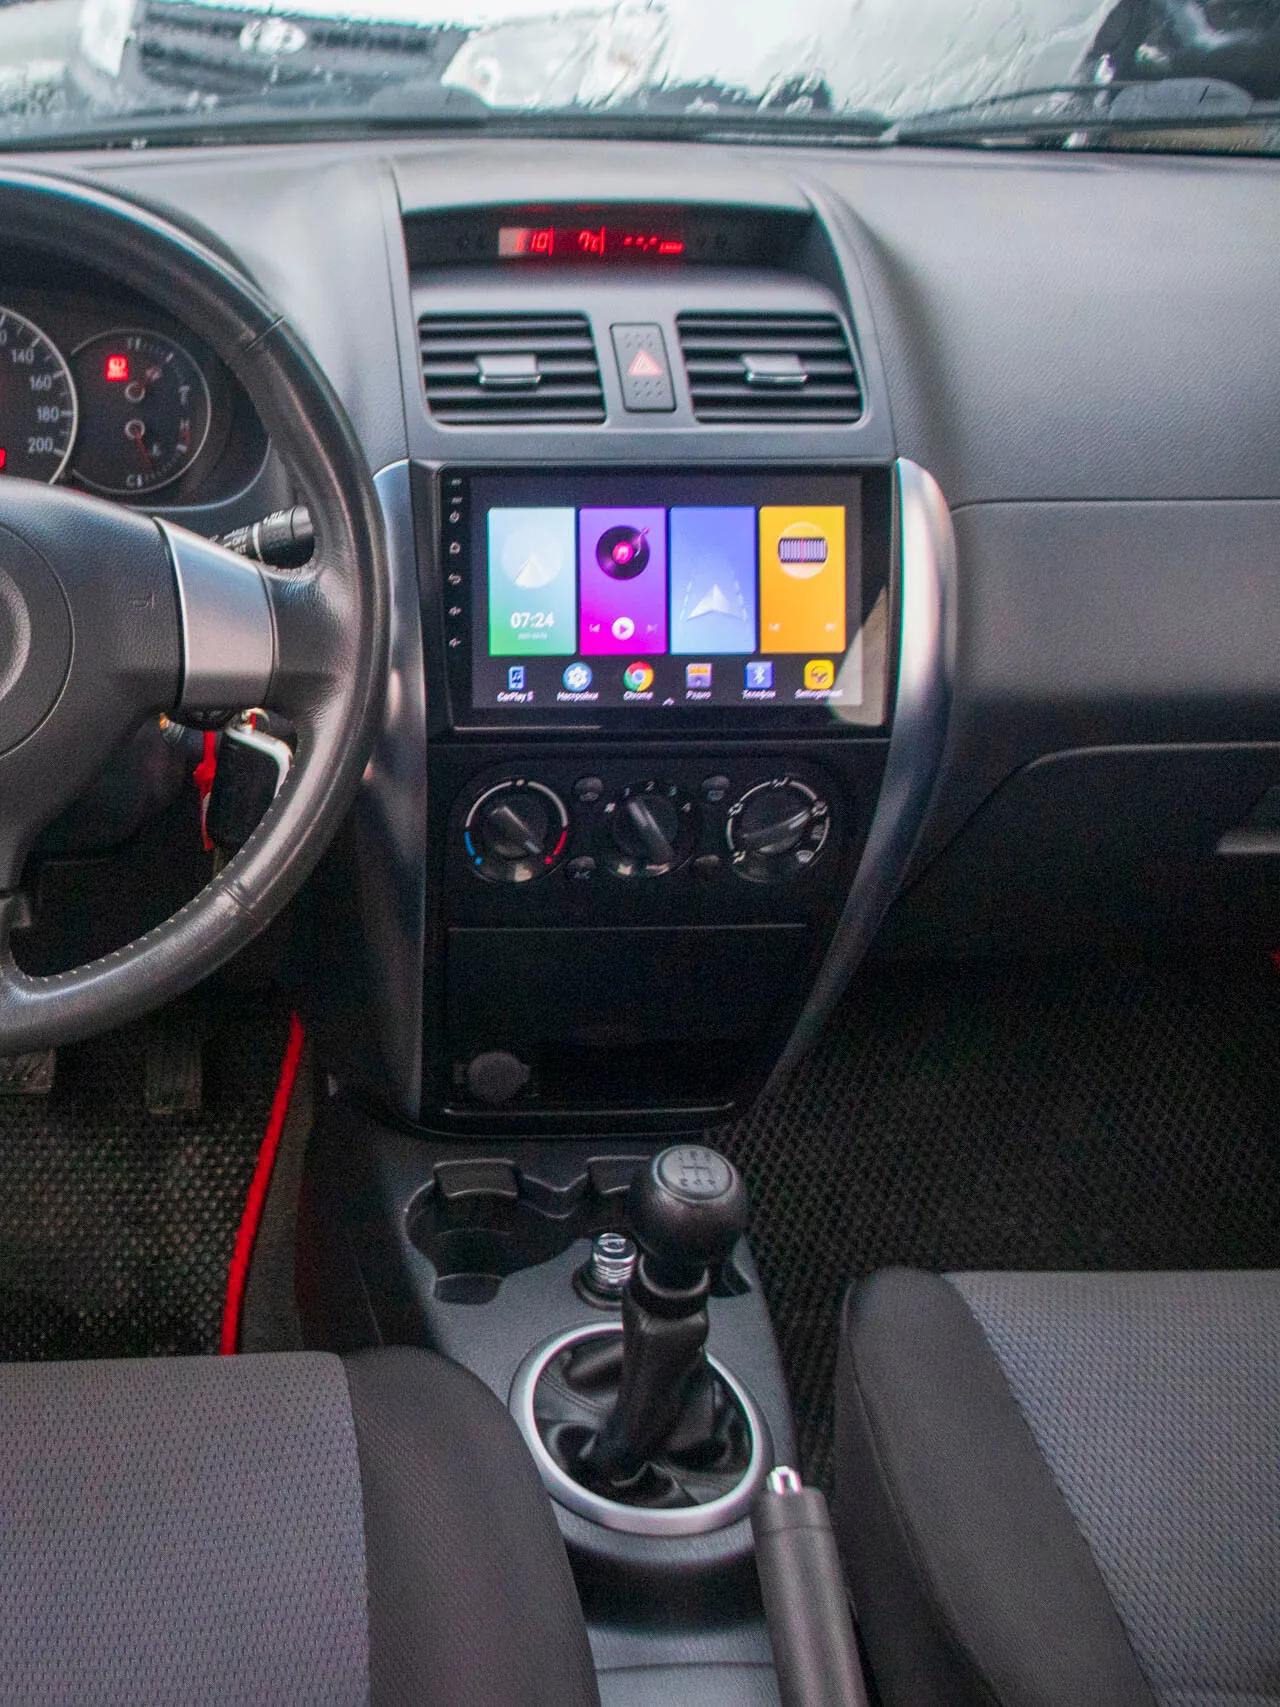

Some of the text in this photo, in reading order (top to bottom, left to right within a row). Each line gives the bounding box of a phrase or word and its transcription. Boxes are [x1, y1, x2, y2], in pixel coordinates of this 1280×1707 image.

[11, 349, 35, 364] 140
[30, 375, 52, 390] 160
[36, 407, 60, 422] 180
[28, 438, 54, 454] 200
[510, 611, 555, 629] 07:24
[623, 691, 654, 701] Chrome
